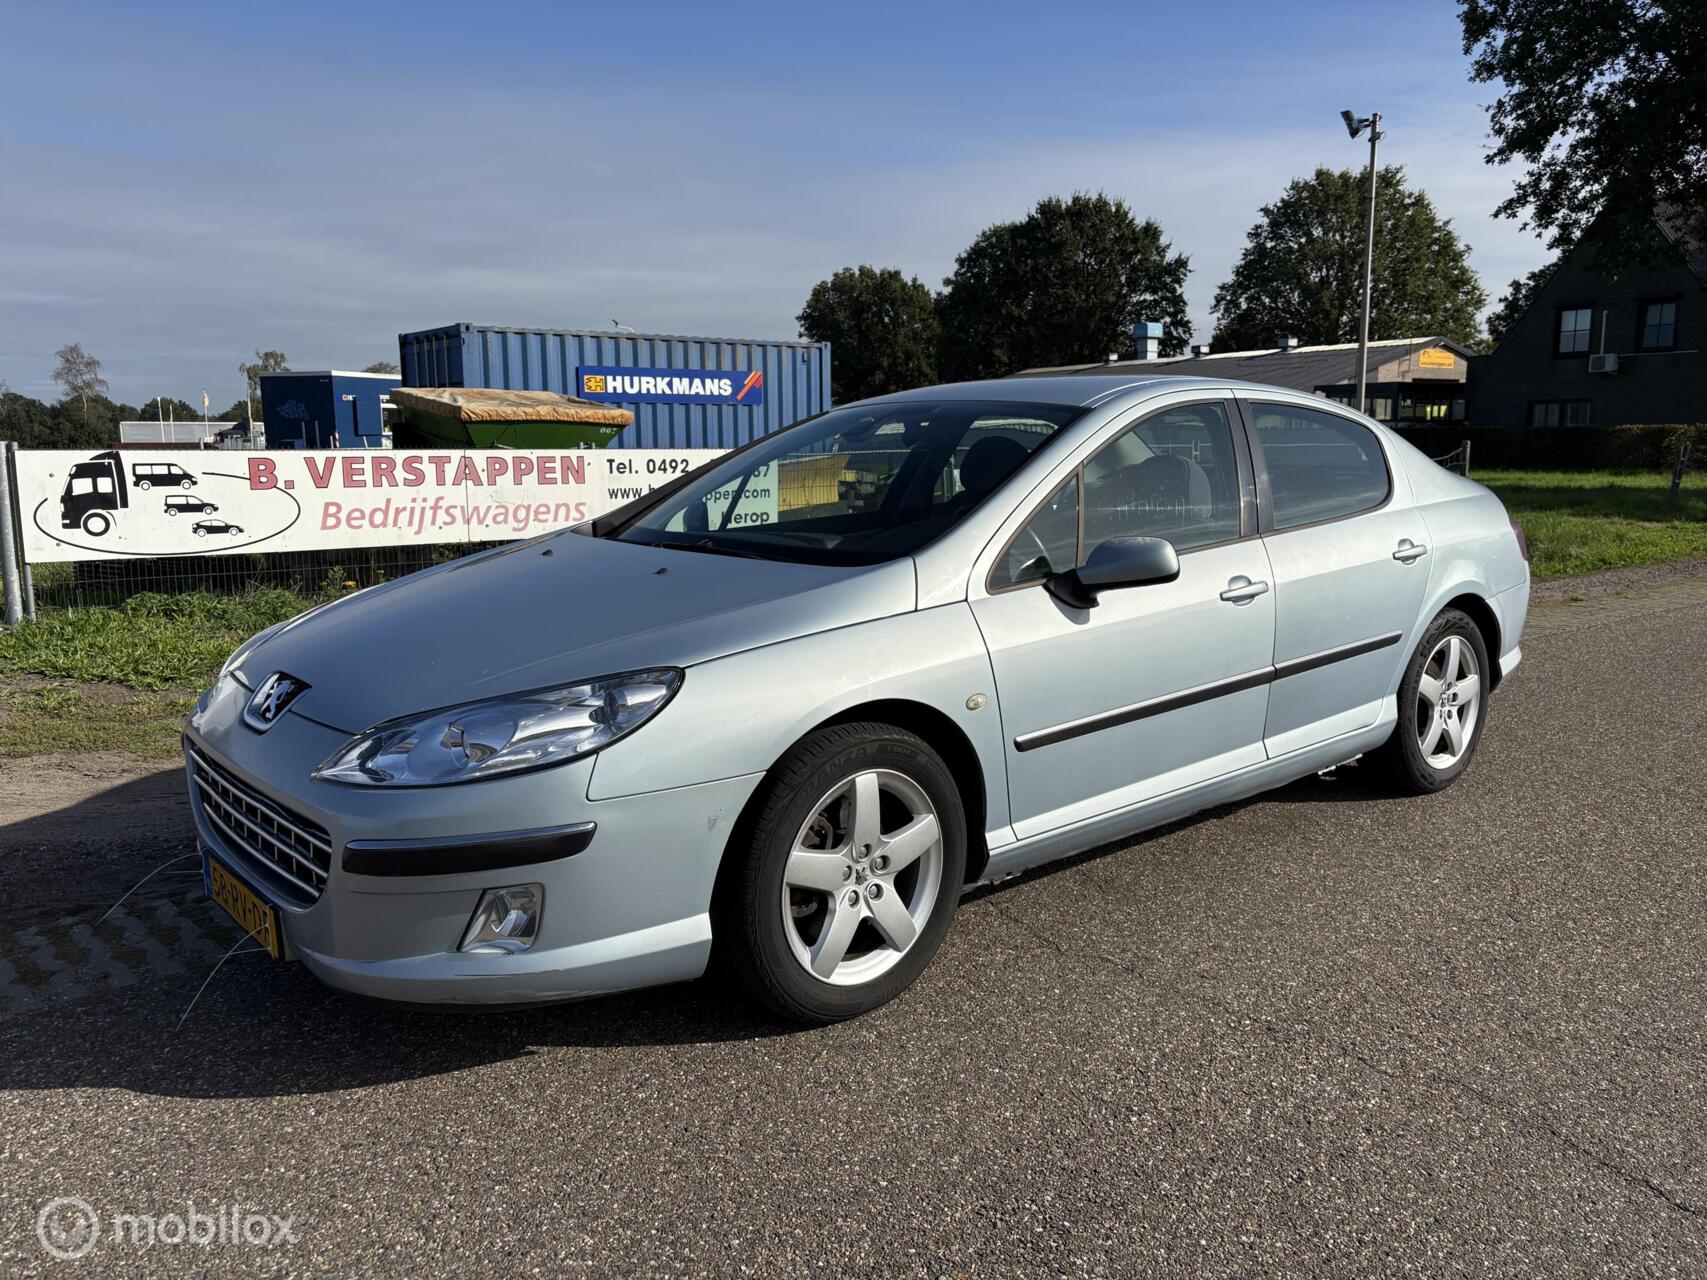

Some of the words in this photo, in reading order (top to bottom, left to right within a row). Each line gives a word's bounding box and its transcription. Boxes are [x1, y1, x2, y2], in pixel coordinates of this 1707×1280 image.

[606, 375, 733, 396] HURKMANS
[247, 457, 295, 490] B.
[303, 455, 586, 489] VERSTAPPEN
[606, 458, 639, 474] Tel.
[646, 458, 690, 474] 0492
[320, 496, 587, 535] Bedrijfswagens
